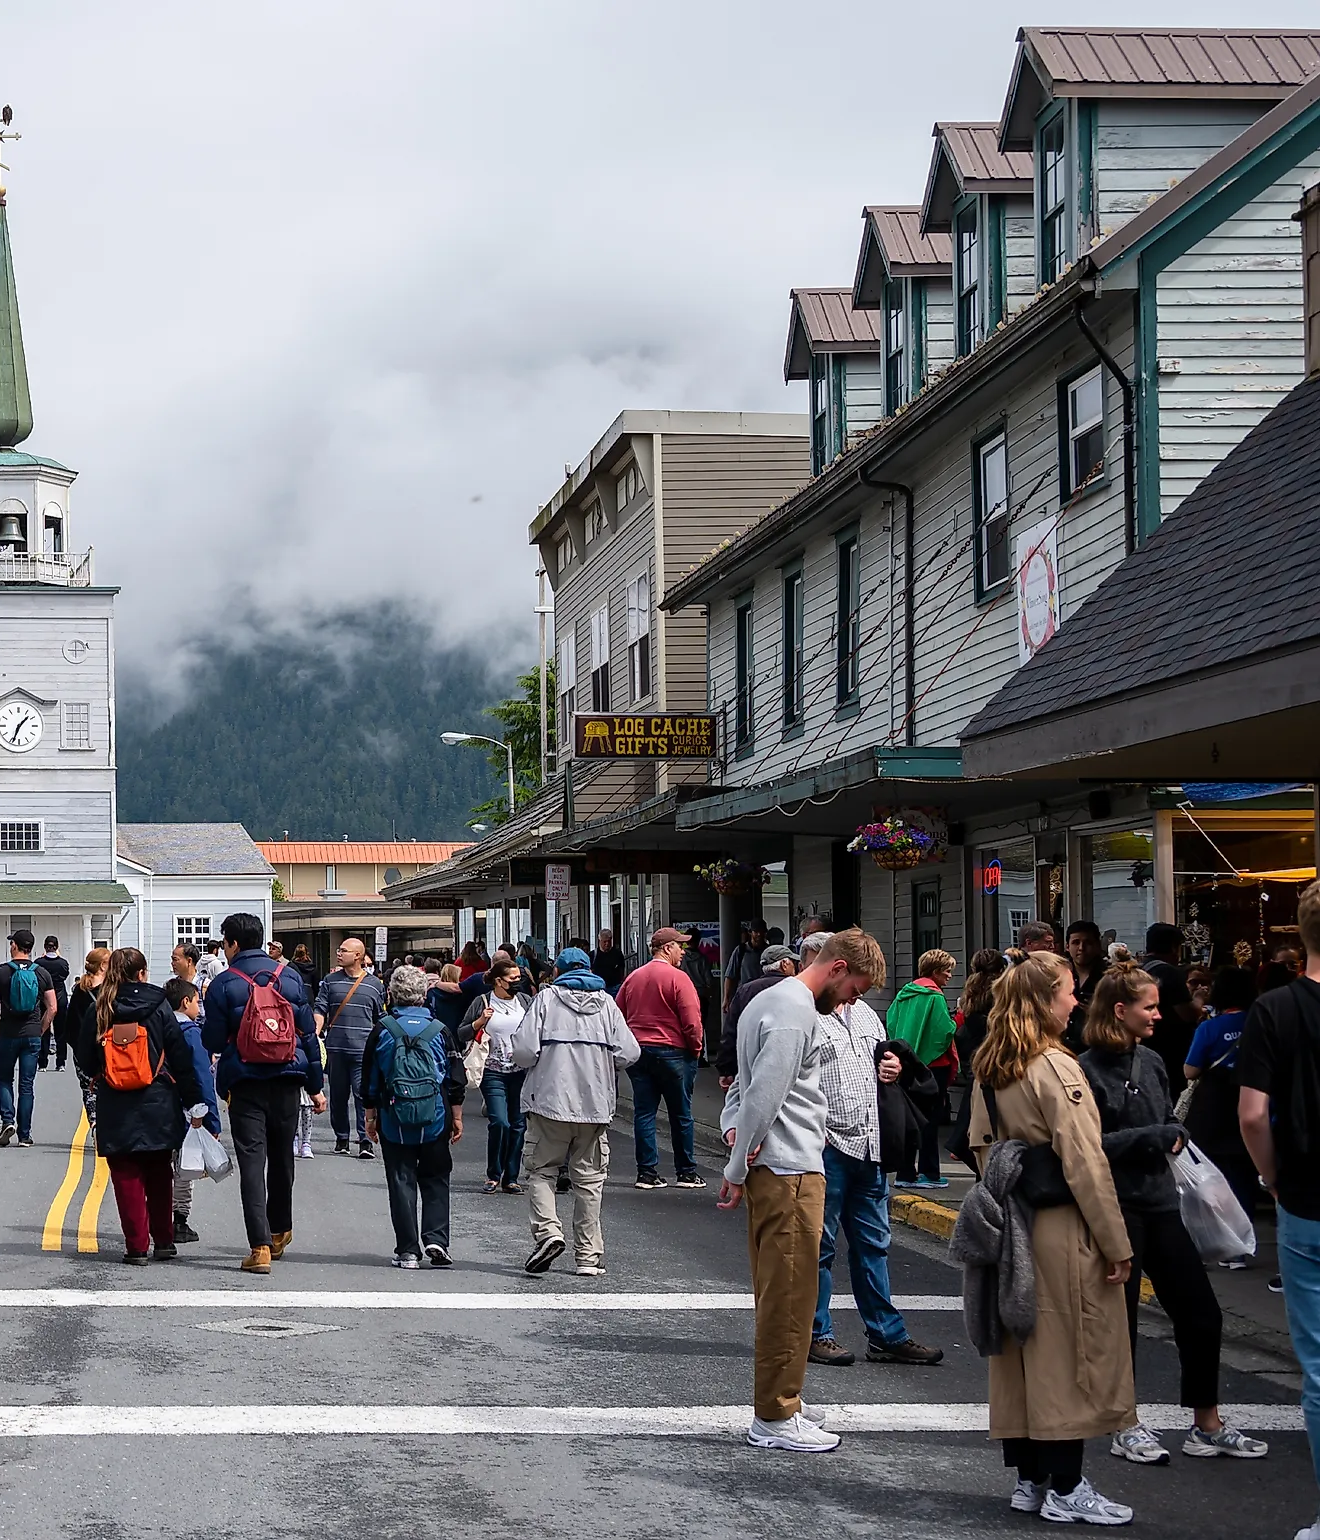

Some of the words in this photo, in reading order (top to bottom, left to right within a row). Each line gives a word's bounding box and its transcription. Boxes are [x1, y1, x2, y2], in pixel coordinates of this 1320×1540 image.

[613, 717, 645, 736] LOG
[651, 718, 711, 736] CACHE
[615, 737, 669, 755] GIFTS
[672, 745, 712, 755] JEWELRY
